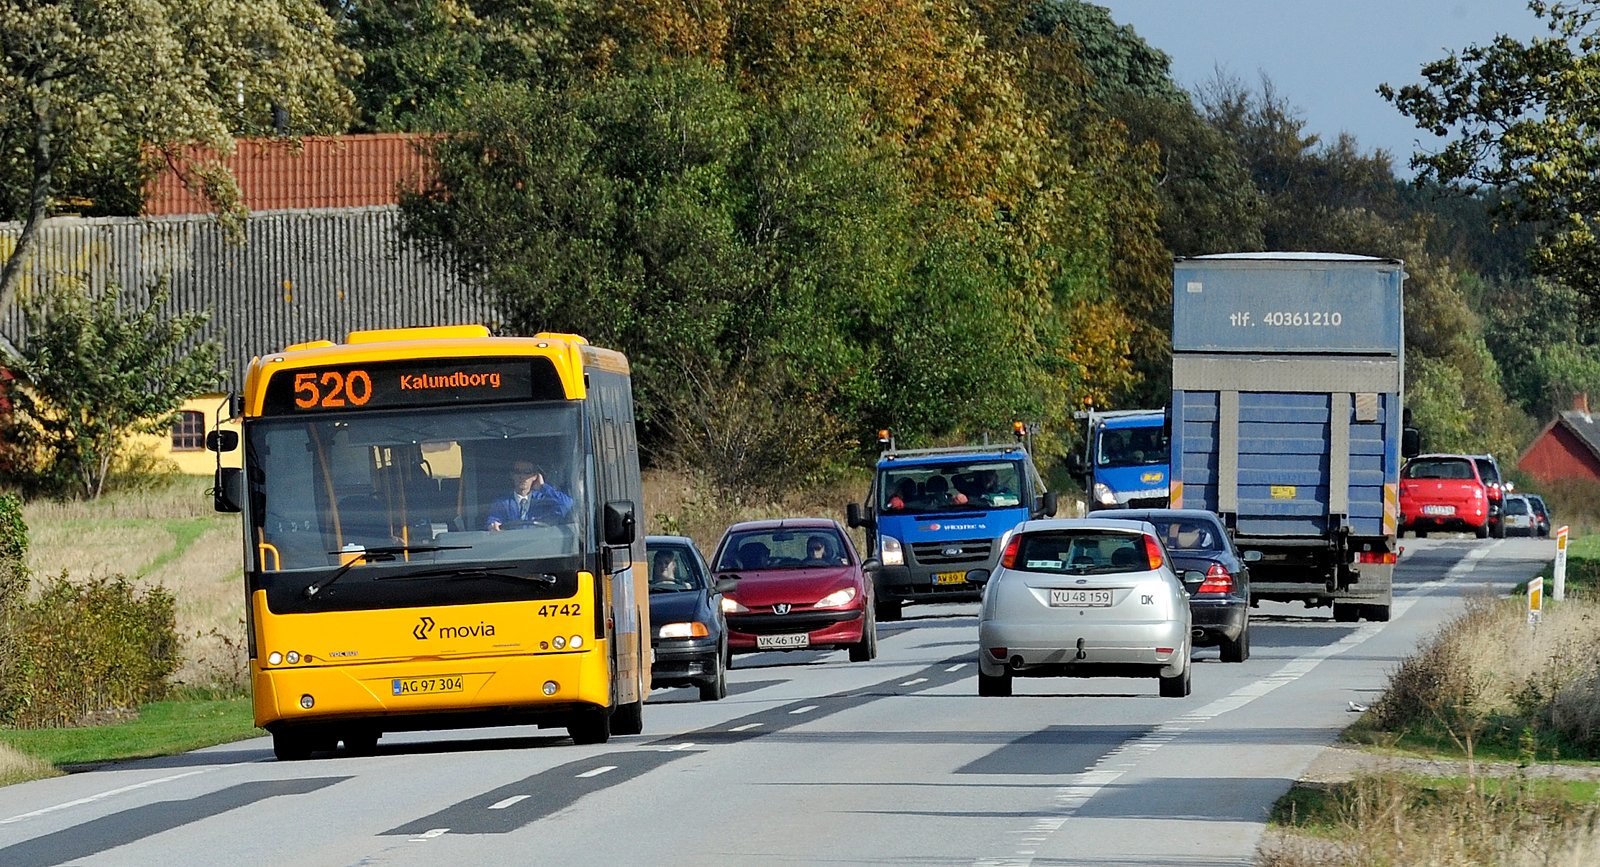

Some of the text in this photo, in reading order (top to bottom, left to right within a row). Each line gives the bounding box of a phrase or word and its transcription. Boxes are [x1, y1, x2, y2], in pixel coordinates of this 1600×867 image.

[1229, 311, 1343, 327] tlf. 40361210
[294, 369, 501, 410] 520 Kalundborg
[1053, 591, 1110, 603] YU 48 159
[1140, 594, 1154, 606] DK
[537, 603, 582, 618] 4742
[439, 620, 496, 639] movia
[759, 635, 807, 645] VK 46 192
[401, 676, 463, 693] AG 97 304
